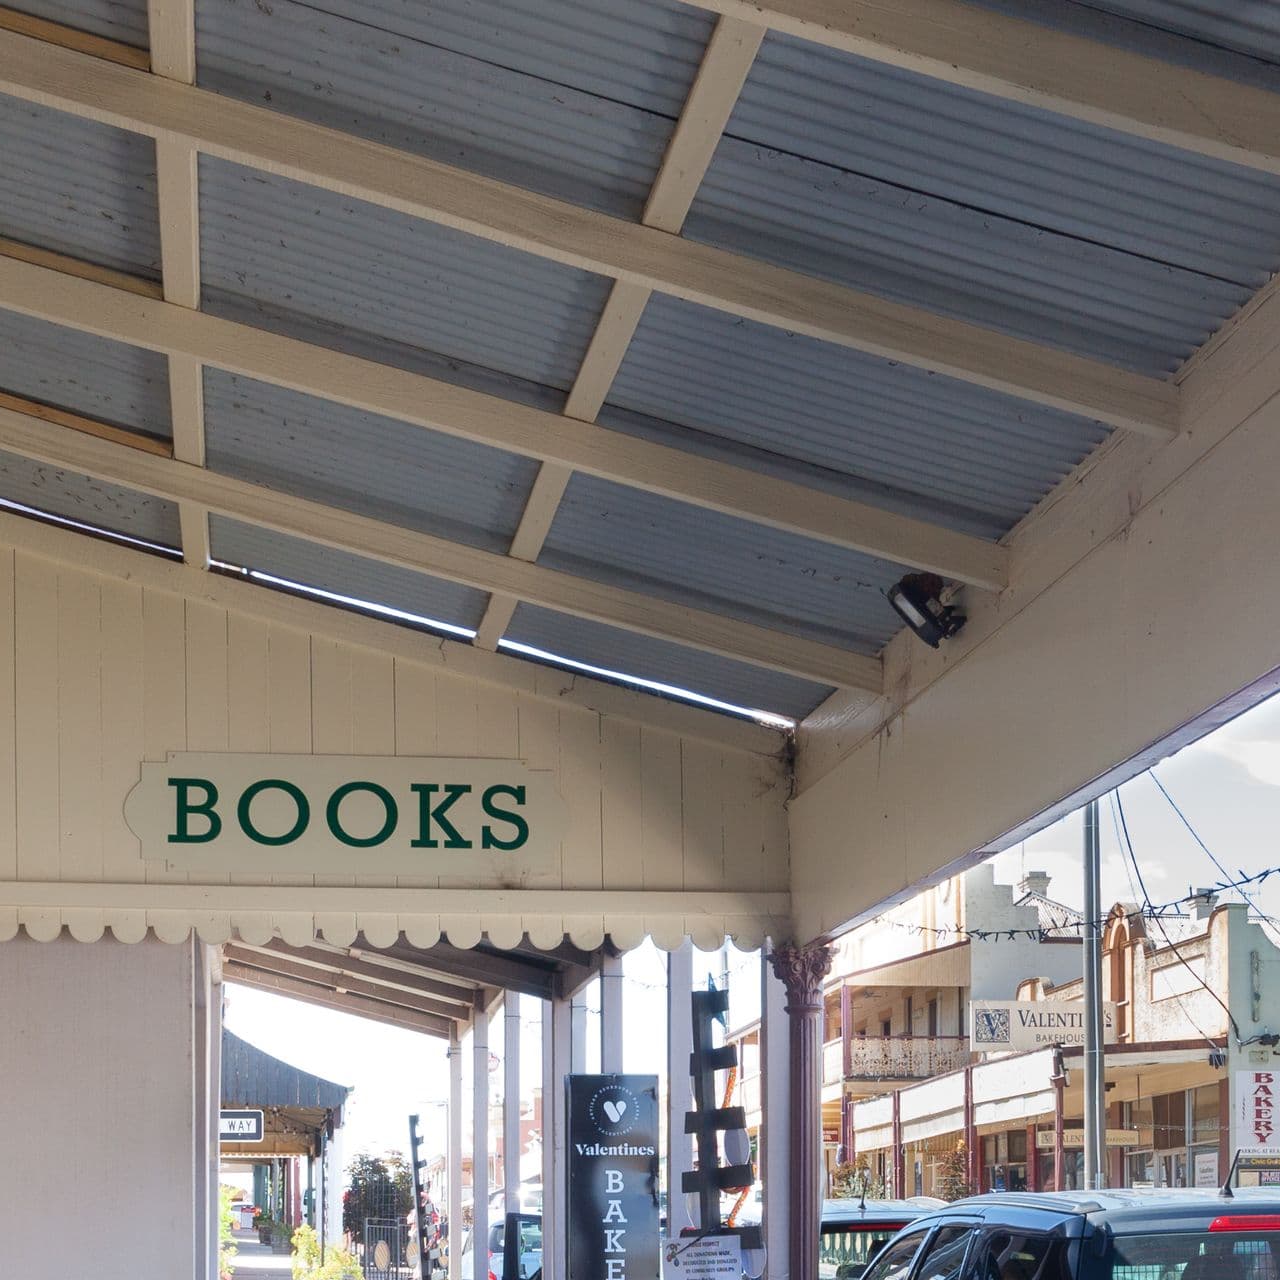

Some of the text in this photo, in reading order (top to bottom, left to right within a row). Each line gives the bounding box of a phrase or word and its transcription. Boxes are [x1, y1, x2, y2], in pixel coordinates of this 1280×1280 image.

[167, 776, 530, 851] BOOKS
[1018, 1009, 1112, 1028] VALENTI'S
[1036, 1033, 1086, 1043] BAKEHOUS
[1253, 1072, 1274, 1144] BAKERY
[228, 1120, 252, 1132] WAY
[575, 1142, 655, 1156] Valentines
